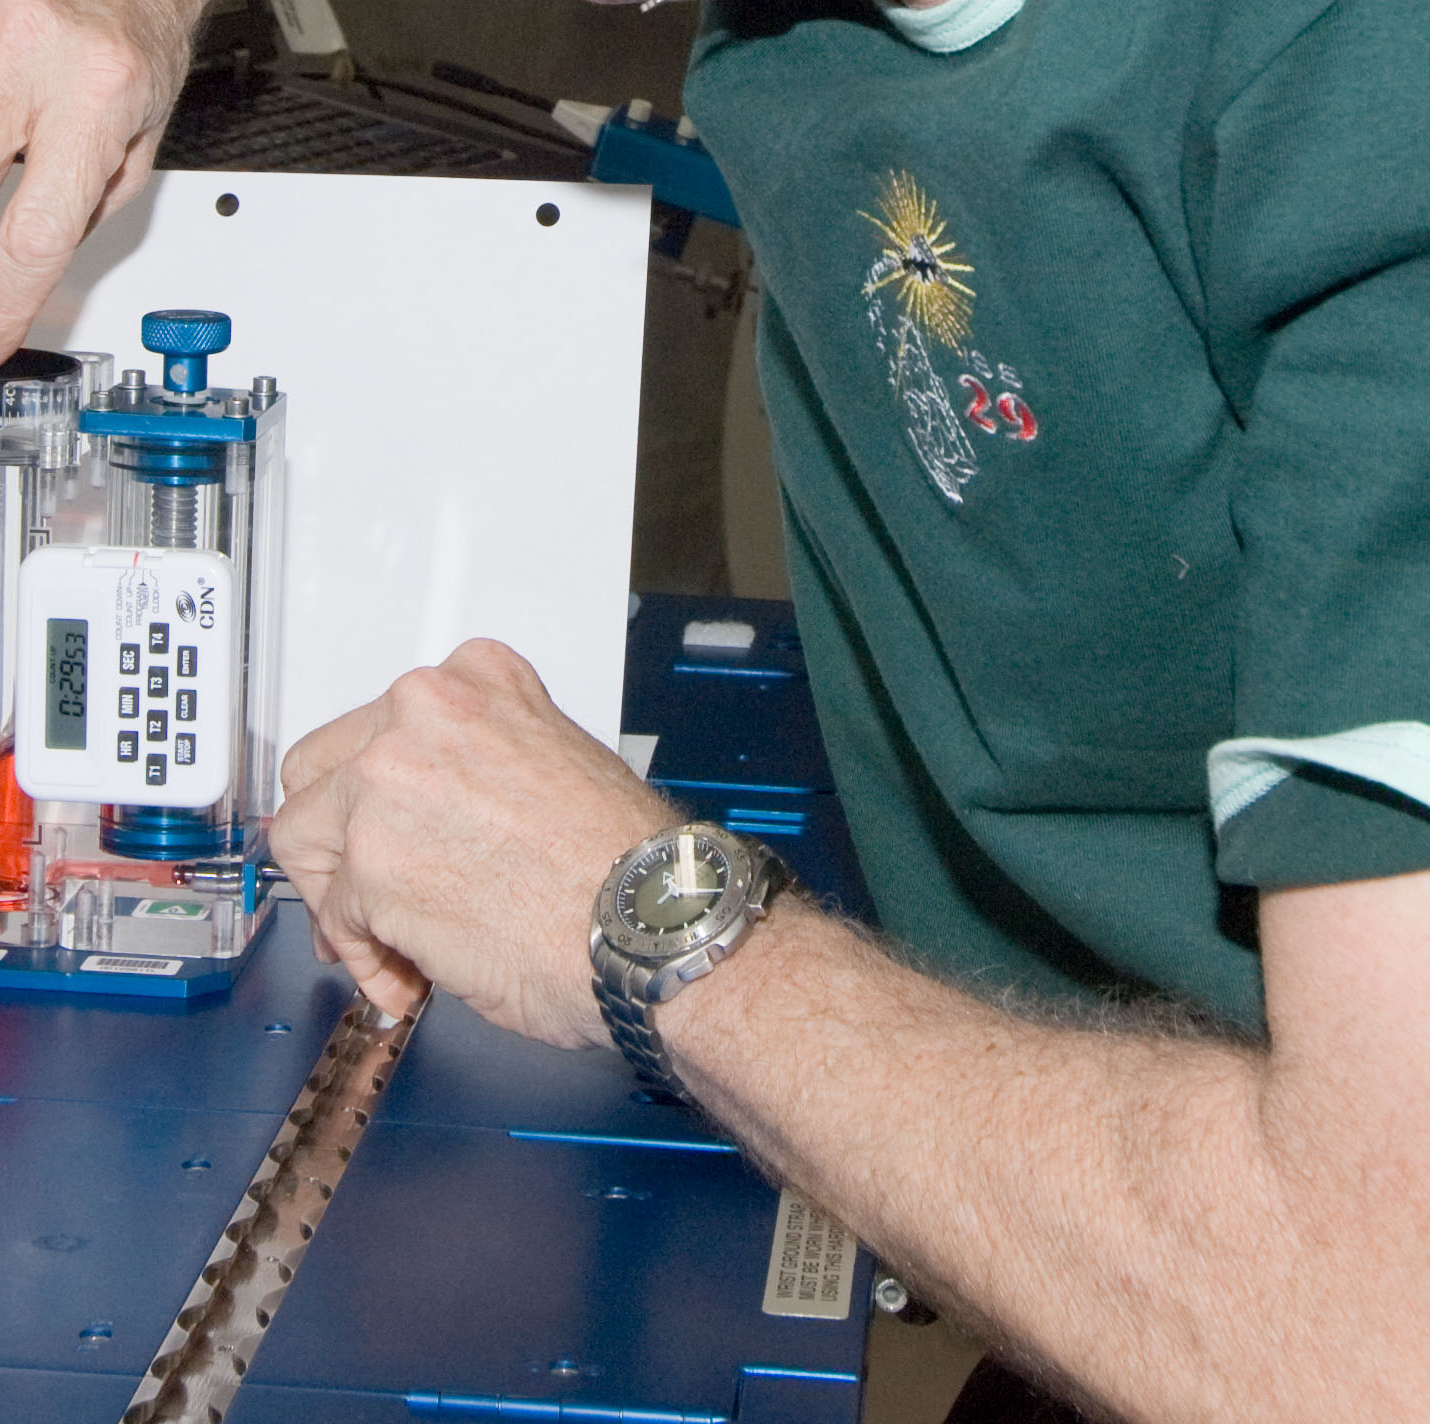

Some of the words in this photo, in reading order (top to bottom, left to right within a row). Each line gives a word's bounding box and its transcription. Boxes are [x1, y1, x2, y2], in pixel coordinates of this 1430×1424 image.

[958, 373, 1038, 443] 29
[199, 587, 216, 630] CDN
[152, 633, 163, 645] T4
[123, 650, 135, 670] SEC
[151, 677, 162, 690] T3
[122, 694, 133, 714] MIN
[181, 695, 189, 718] CLEAR
[150, 720, 161, 733] T2
[121, 741, 132, 755] HR
[149, 766, 160, 777] T1
[781, 1232, 802, 1269] GROUND
[803, 1233, 823, 1260] WORN
[802, 1261, 819, 1274] BE
[824, 1252, 843, 1272] THIS
[776, 1269, 796, 1298] WRIST
[798, 1274, 818, 1301] MUST
[821, 1274, 840, 1302] USING
